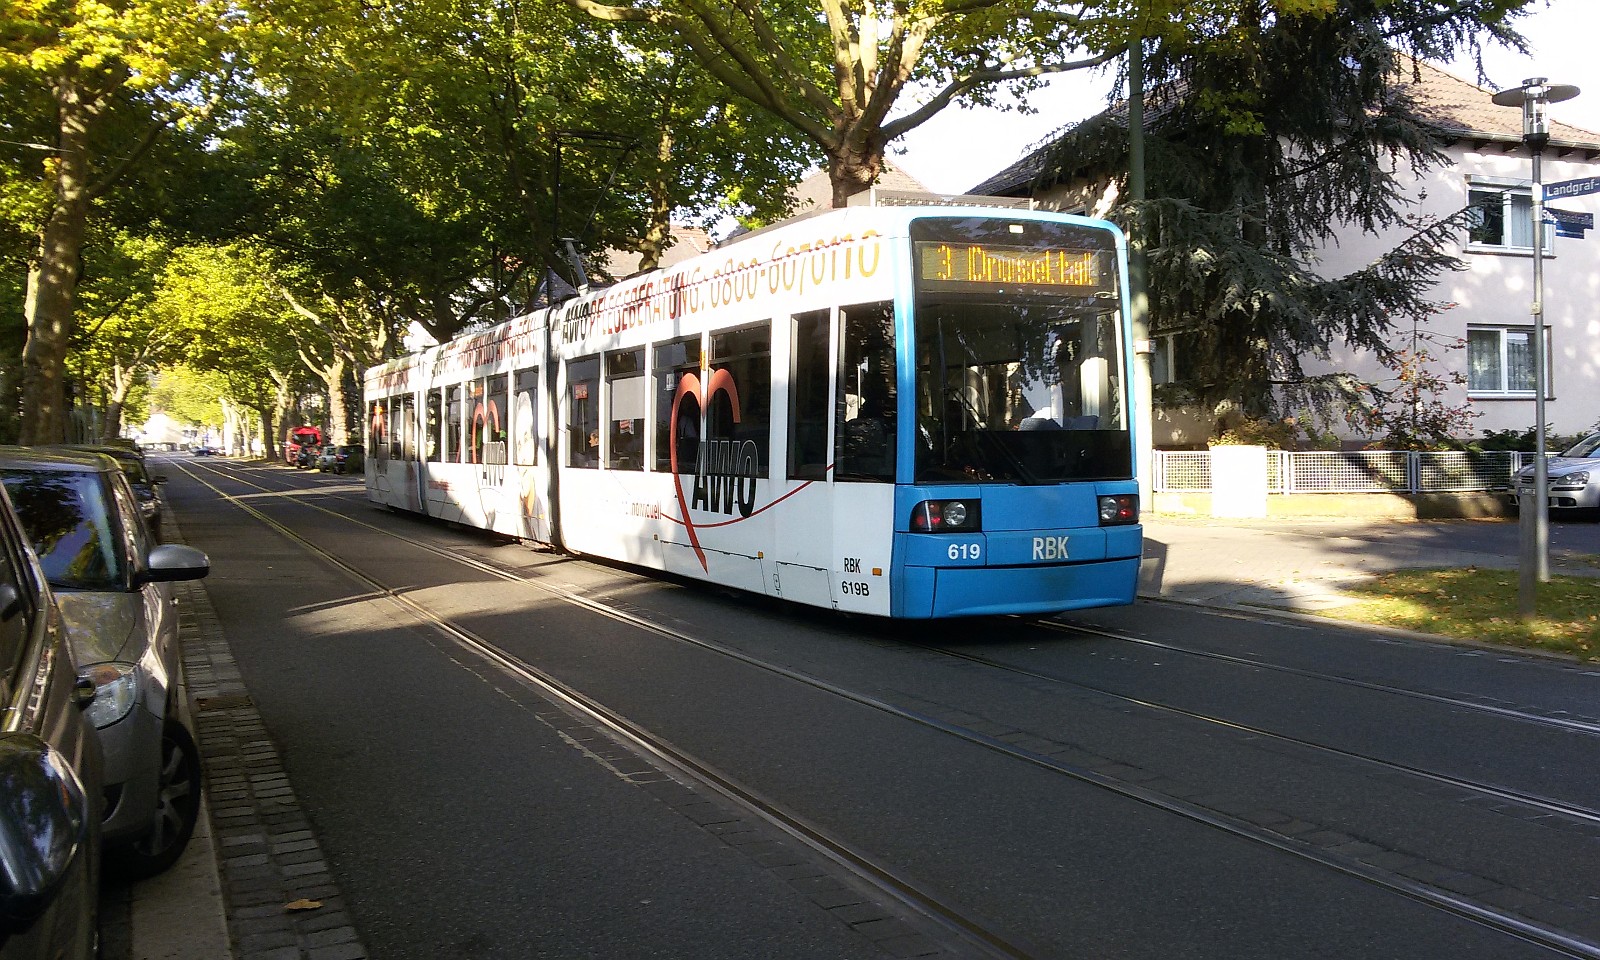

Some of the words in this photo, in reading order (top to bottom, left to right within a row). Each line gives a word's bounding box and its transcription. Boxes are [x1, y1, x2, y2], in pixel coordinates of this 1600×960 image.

[1546, 178, 1600, 197] Landgraf-
[937, 244, 952, 280] 3
[691, 439, 759, 518] AWO
[947, 543, 981, 560] 619
[1032, 536, 1069, 560] RBK
[844, 557, 861, 574] RBK
[841, 580, 870, 597] 619B
